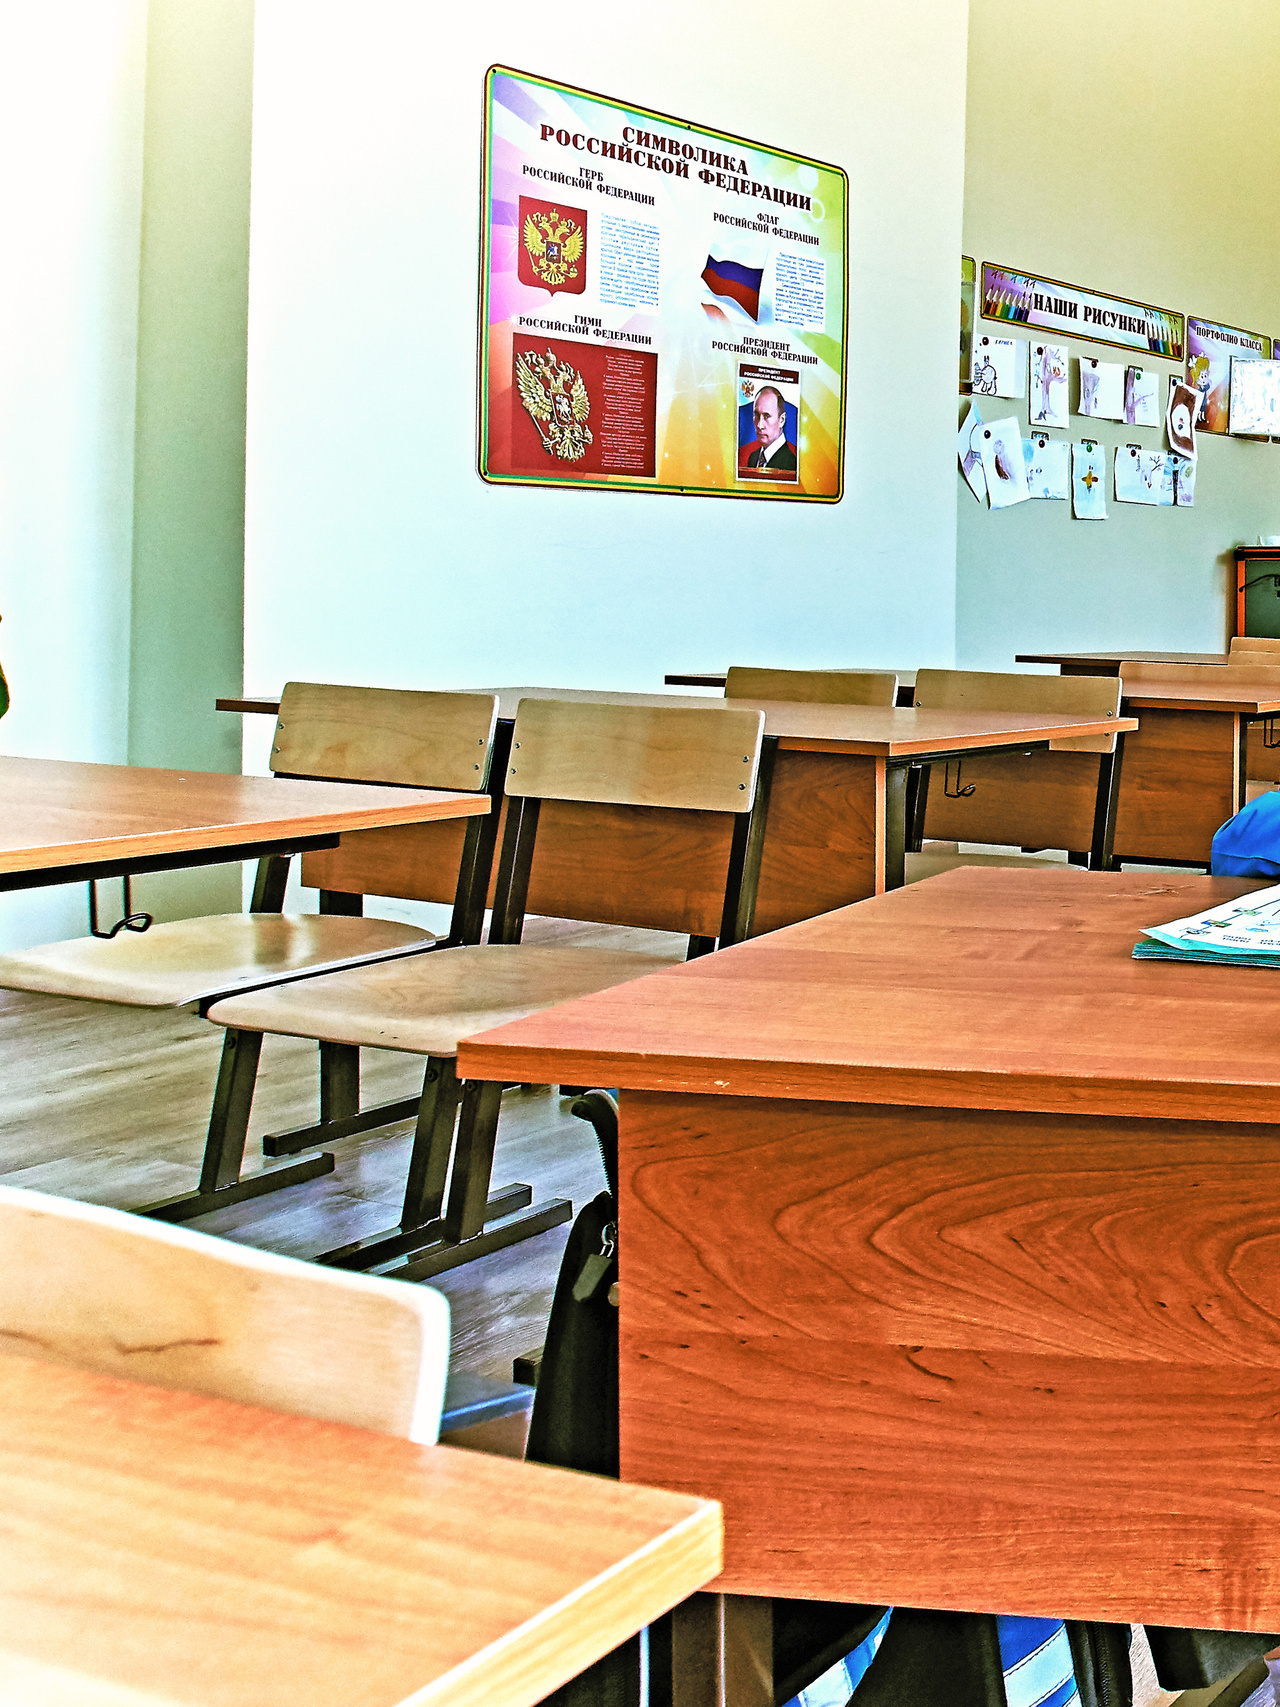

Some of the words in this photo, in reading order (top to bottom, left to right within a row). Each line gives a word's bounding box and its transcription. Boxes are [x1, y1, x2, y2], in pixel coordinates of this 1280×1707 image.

[622, 126, 749, 176] СИМВОЛИКА
[539, 123, 690, 179] РОССИЙСКОЙ
[698, 168, 813, 212] ФЕДЕРАЦИИ
[579, 167, 604, 182] ГЕРБ
[522, 164, 593, 191] РОССИЙСКОЙ
[596, 183, 656, 206] ФЕДЕРАЦИИ
[713, 211, 770, 234] РОССИЙСКОЙ
[771, 227, 820, 246] ФЕДЕРАЦИИ
[757, 213, 780, 225] ФЛАГ
[574, 314, 602, 328] ГИМН
[1033, 293, 1079, 321] НАШИ
[1083, 304, 1147, 336] РИСУНКИ
[518, 316, 590, 336] РОССИЙСКОЙ
[592, 328, 652, 346] ФЕДЕРАЦИИ
[743, 336, 791, 352] ПРЕЗИДЕНТ
[1195, 325, 1239, 348] ПОРТФОЛИО
[1239, 335, 1264, 352] КЛАССА
[712, 339, 768, 358] РОССИЙСКОЙ
[770, 349, 819, 366] ФЕДЕРАЦИИ
